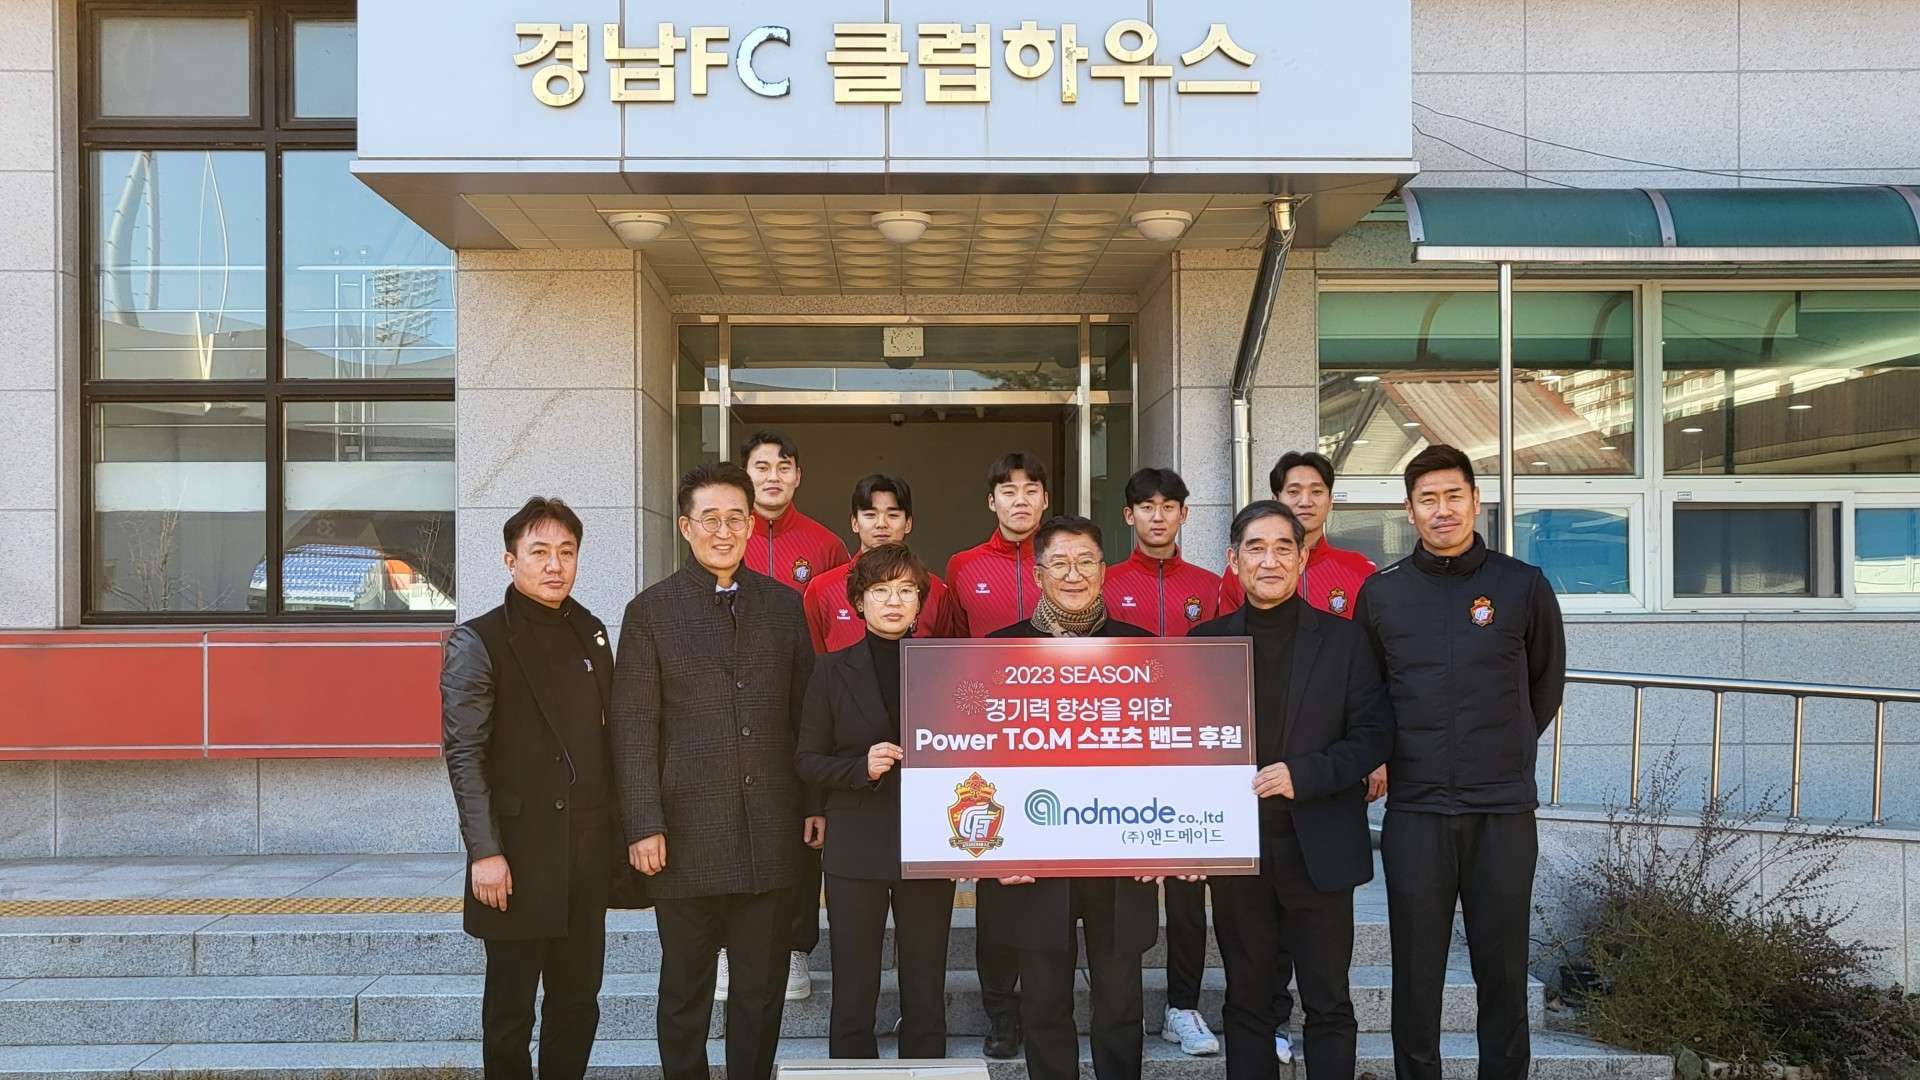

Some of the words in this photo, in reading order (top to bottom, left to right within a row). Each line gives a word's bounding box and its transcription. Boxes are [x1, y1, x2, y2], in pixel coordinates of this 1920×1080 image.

[513, 22, 791, 107] 경남FC
[825, 19, 1261, 104] 클럽하우스
[1004, 665, 1056, 685] 2023
[1059, 664, 1151, 684] SEASON
[985, 698, 1051, 722] 경기력
[1056, 698, 1122, 722] 향상을
[1127, 697, 1172, 721] 위한
[915, 728, 998, 751] Power
[1002, 728, 1072, 750] T.O.M
[1077, 727, 1143, 749] 스포츠
[1149, 727, 1194, 748] 밴드
[1198, 725, 1243, 749] 후원
[1121, 827, 1225, 846] (주)앤드메이드
